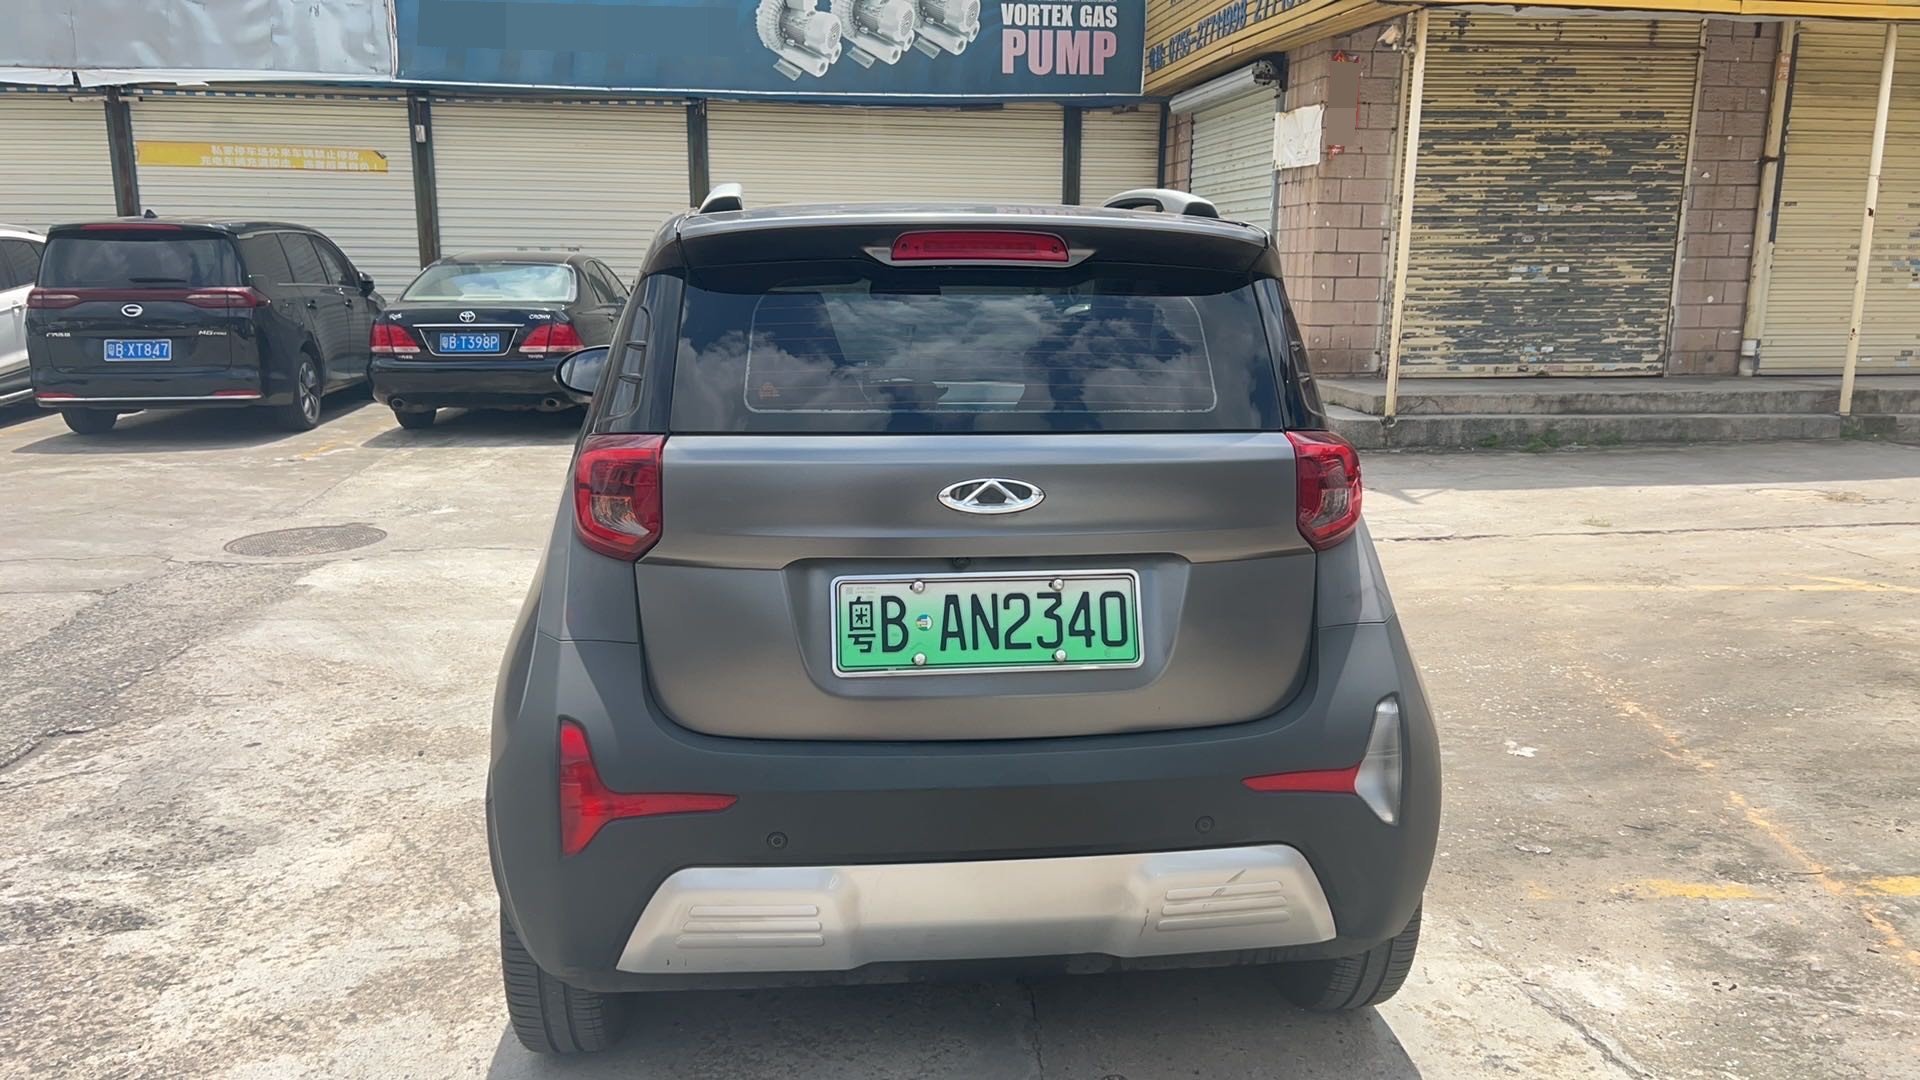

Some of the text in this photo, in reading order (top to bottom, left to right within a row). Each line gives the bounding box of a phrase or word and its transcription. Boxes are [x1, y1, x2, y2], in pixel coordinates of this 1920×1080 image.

[1001, 3, 1117, 27] VORTEX GAS
[1002, 29, 1117, 75] PUMP
